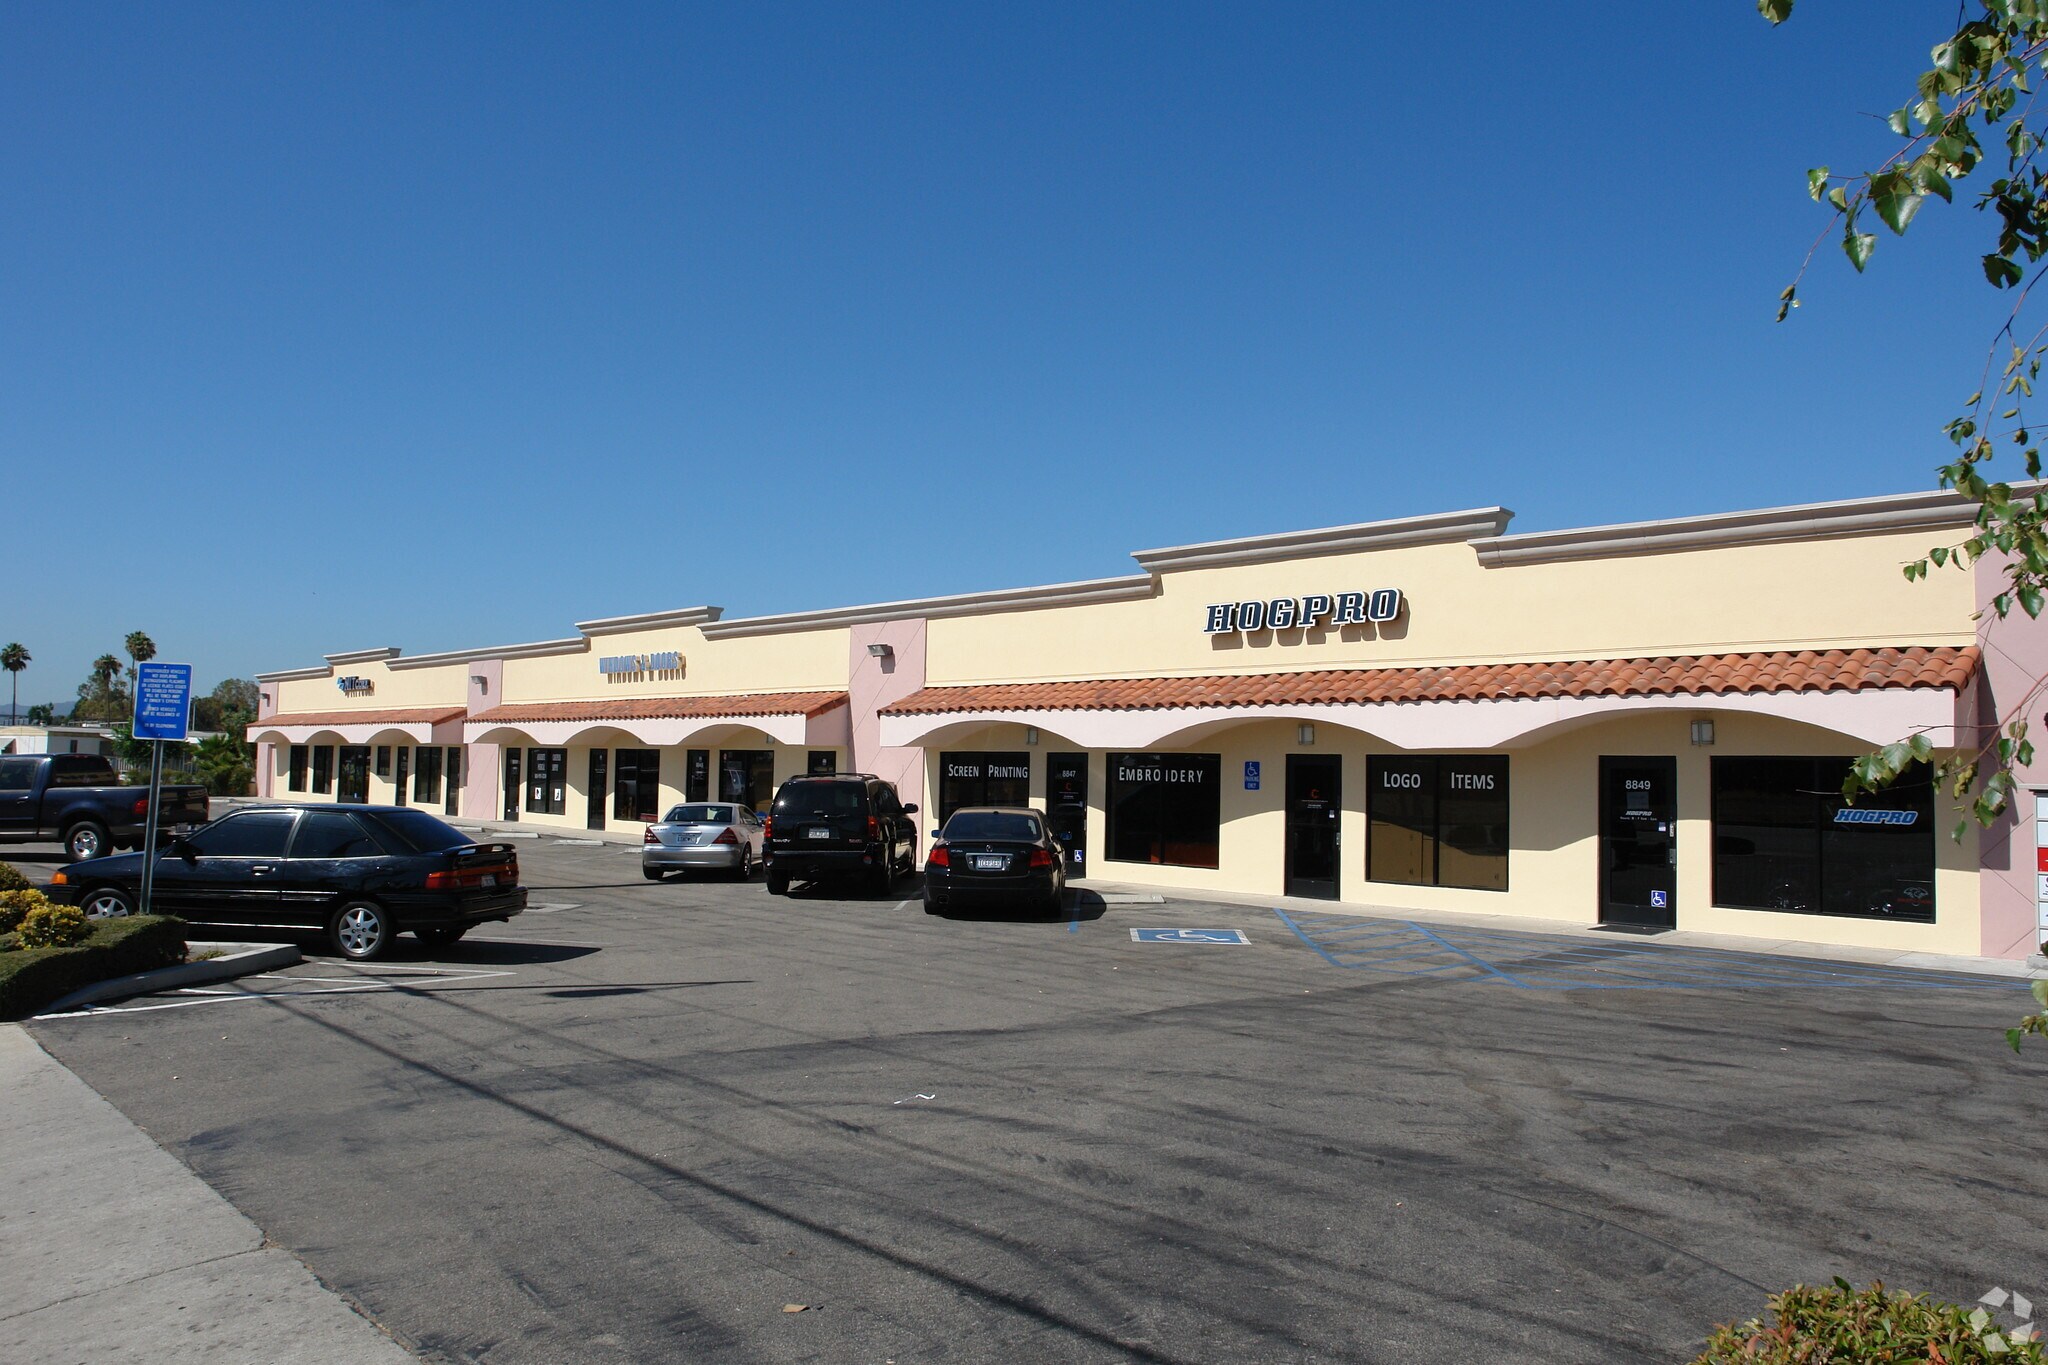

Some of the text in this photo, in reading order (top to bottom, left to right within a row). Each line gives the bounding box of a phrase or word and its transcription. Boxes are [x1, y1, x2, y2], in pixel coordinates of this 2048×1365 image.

[1203, 587, 1403, 634] HOGPRO
[650, 650, 680, 670] DOORS
[948, 764, 1028, 778] SCREEN PRINTING
[1062, 770, 1076, 778] 8847
[1383, 771, 1494, 790] LOGO ITEMS
[1625, 780, 1651, 790] 8849
[1833, 809, 1919, 825] HOGPRO
